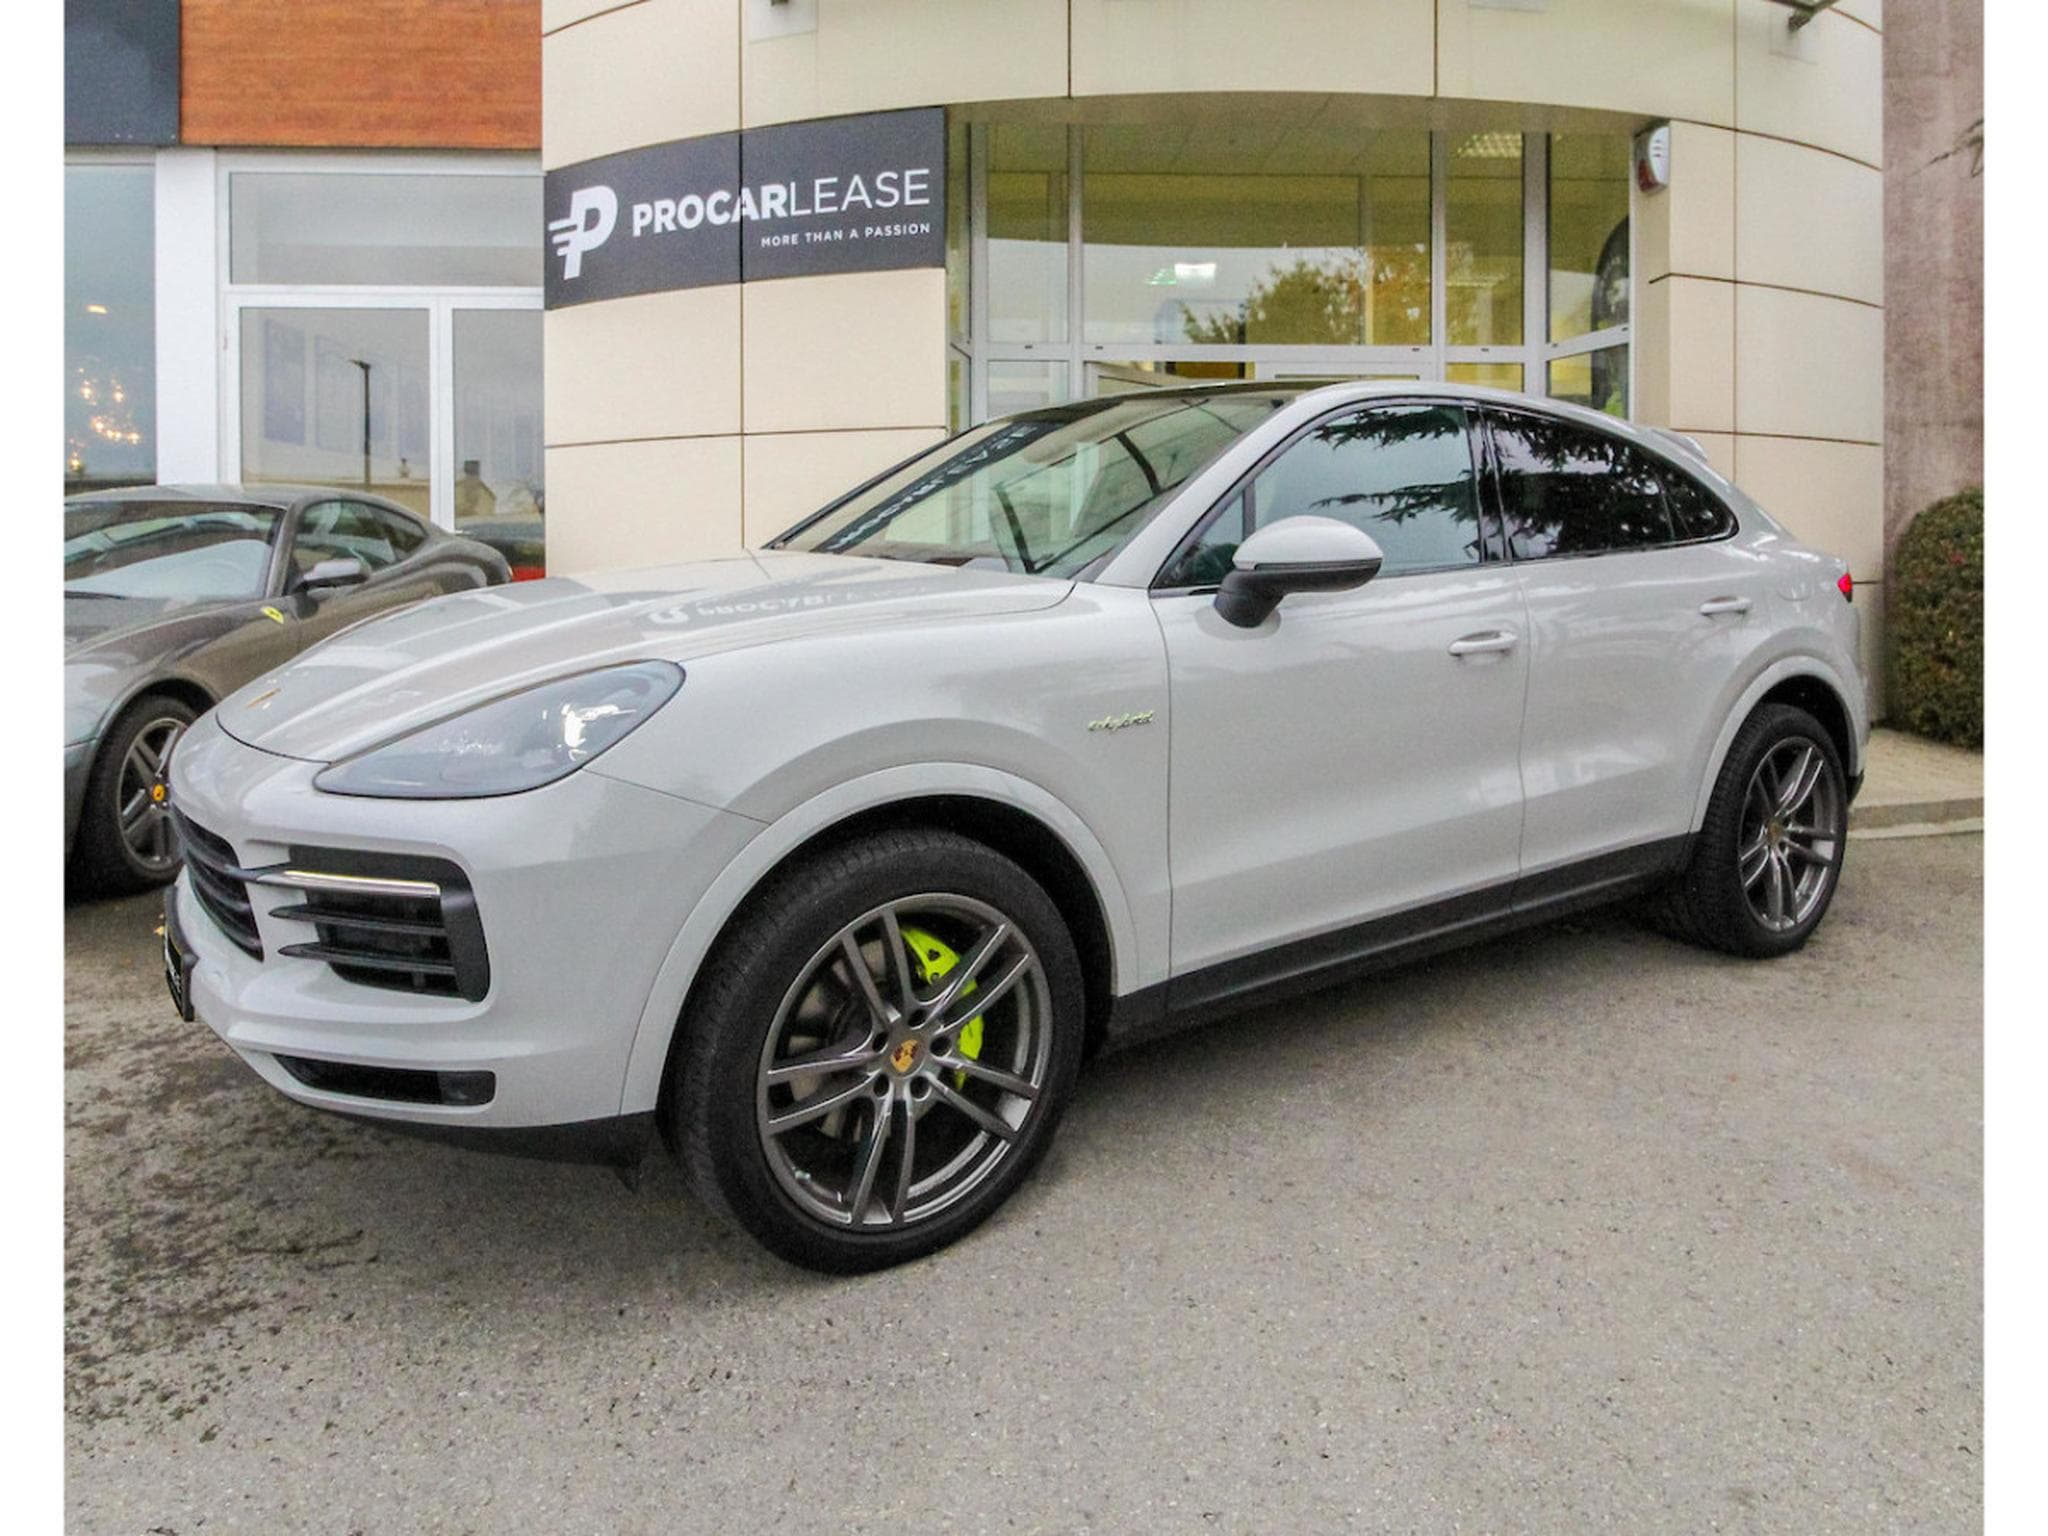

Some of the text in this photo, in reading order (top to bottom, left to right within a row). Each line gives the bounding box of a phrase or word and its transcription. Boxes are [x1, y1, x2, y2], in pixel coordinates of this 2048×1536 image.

[633, 168, 930, 237] PROCARLEASE
[761, 223, 931, 248] MORE THAN A PASSION
